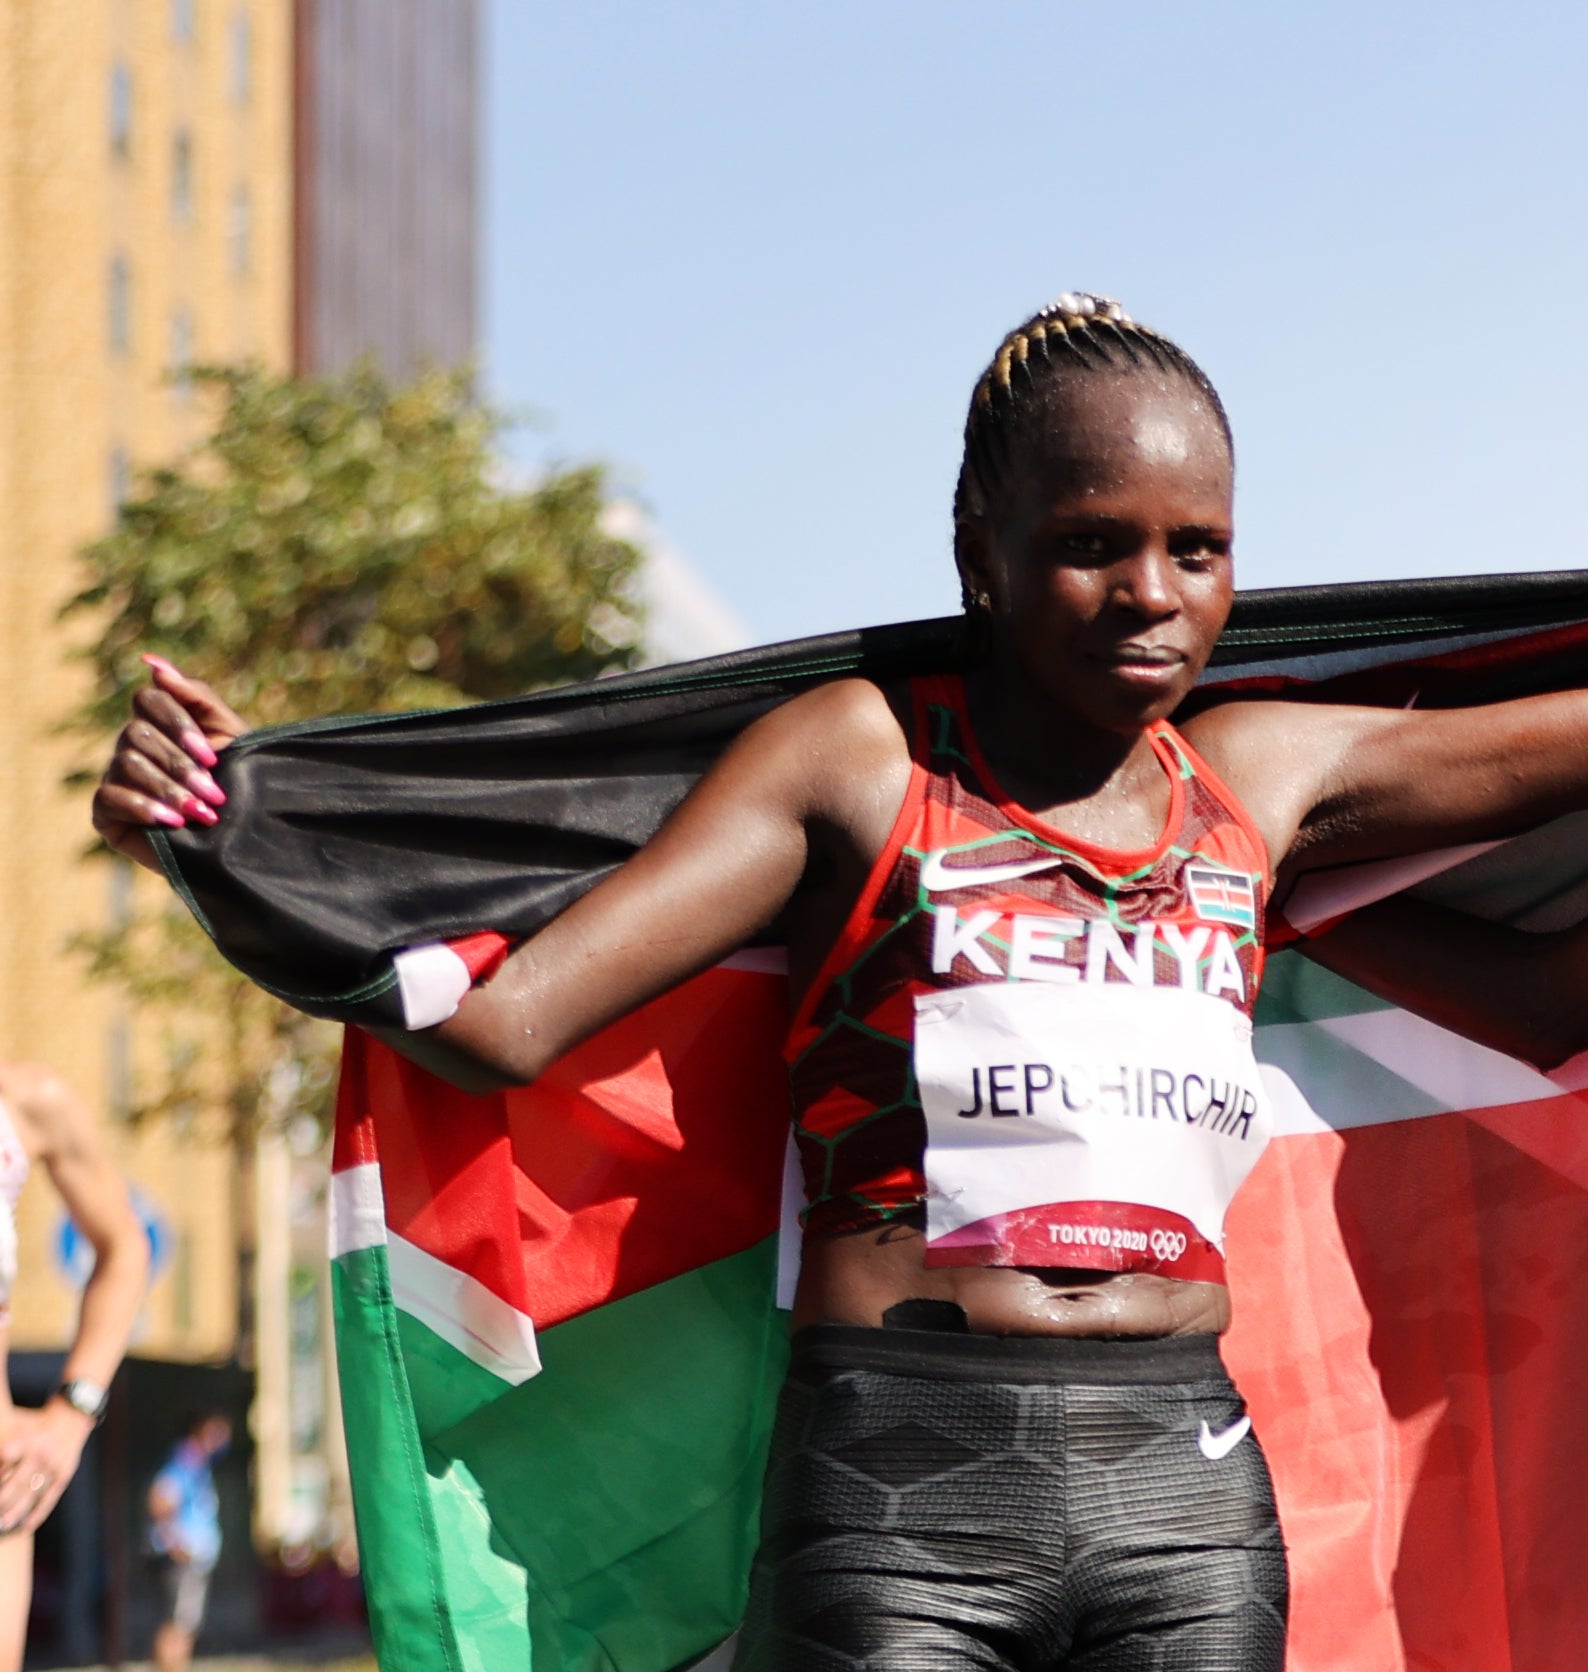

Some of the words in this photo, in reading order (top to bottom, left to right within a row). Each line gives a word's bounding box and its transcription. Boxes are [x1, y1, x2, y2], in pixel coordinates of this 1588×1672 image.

[932, 905, 1246, 1003] KENYA
[957, 1063, 1258, 1140] JEPCHIRCHIR
[1048, 1224, 1111, 1247] TOKYO
[1112, 1229, 1148, 1252] 2020
